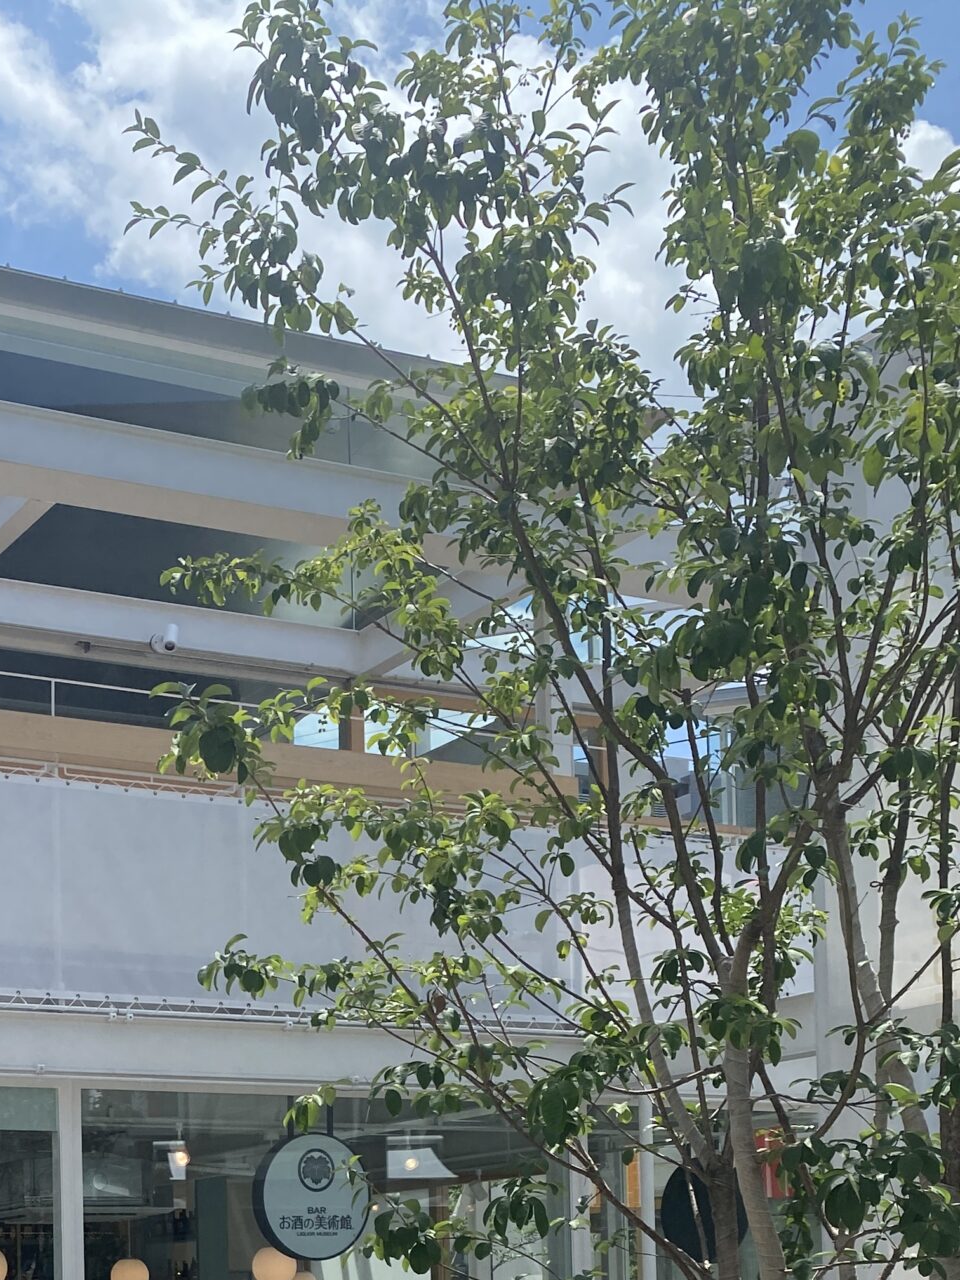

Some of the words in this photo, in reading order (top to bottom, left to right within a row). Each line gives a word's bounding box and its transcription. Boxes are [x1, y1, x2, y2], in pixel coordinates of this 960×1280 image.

[307, 1206, 327, 1214] BAR
[279, 1215, 352, 1230] お酒の美術館
